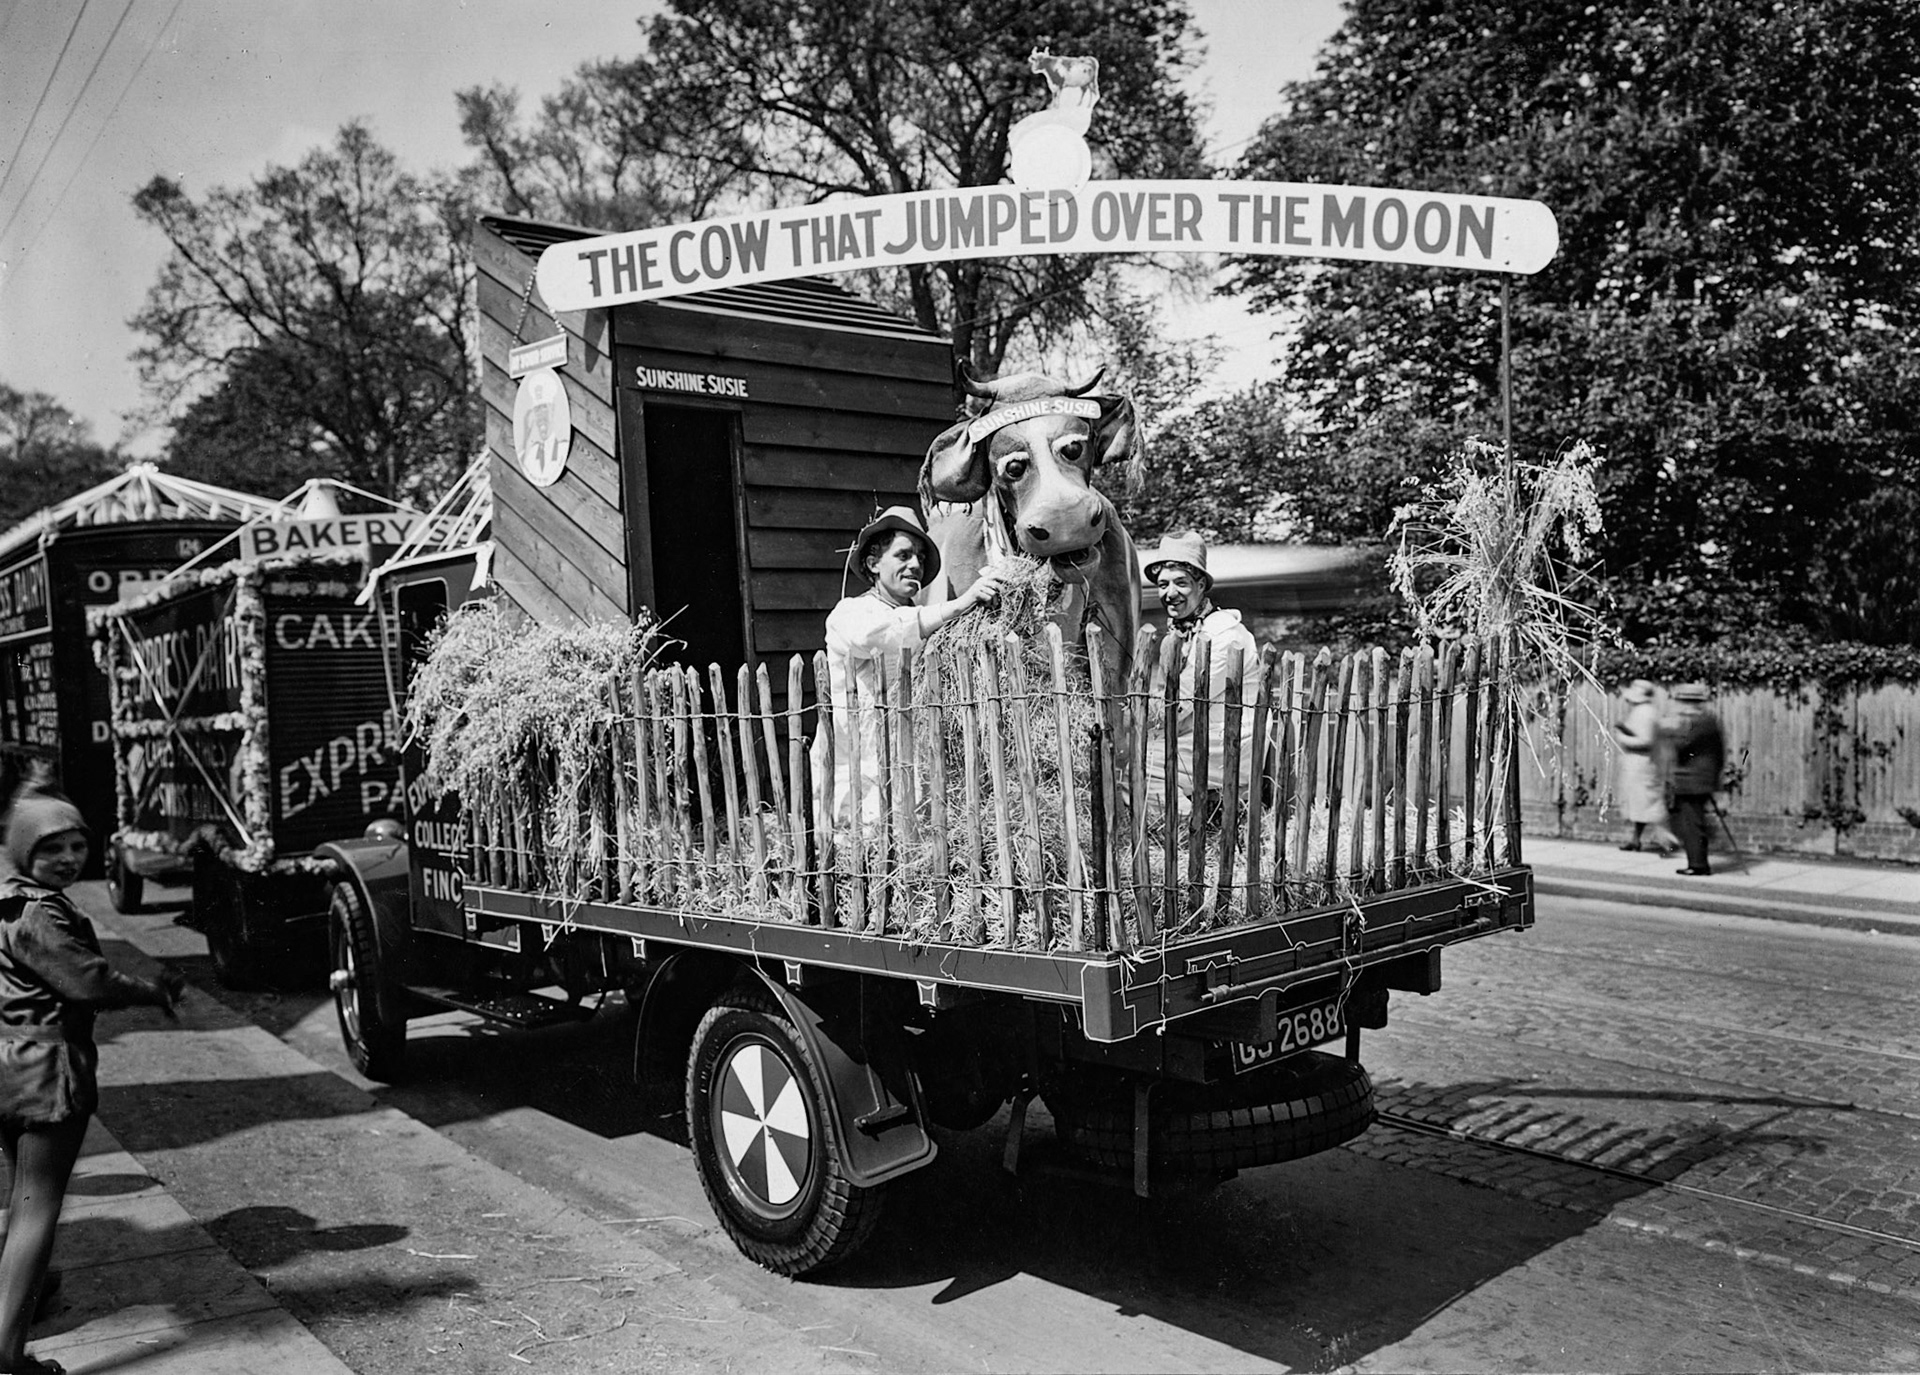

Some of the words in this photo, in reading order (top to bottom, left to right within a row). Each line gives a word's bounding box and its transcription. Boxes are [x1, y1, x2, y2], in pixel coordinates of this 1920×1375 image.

[578, 241, 663, 297] THE
[669, 219, 770, 284] COW
[780, 209, 883, 267] THAT
[883, 189, 1078, 255] JUMPED
[1092, 193, 1203, 243] OVER
[1218, 194, 1313, 246] THE
[1322, 195, 1496, 260] MOON
[636, 366, 707, 393] SUNSHINE
[707, 374, 749, 398] SUSIE
[972, 401, 1051, 435] SUNSHINE
[1052, 399, 1096, 416] SUSIE
[252, 519, 413, 555] BAKERY
[1278, 1003, 1340, 1053] 2688
